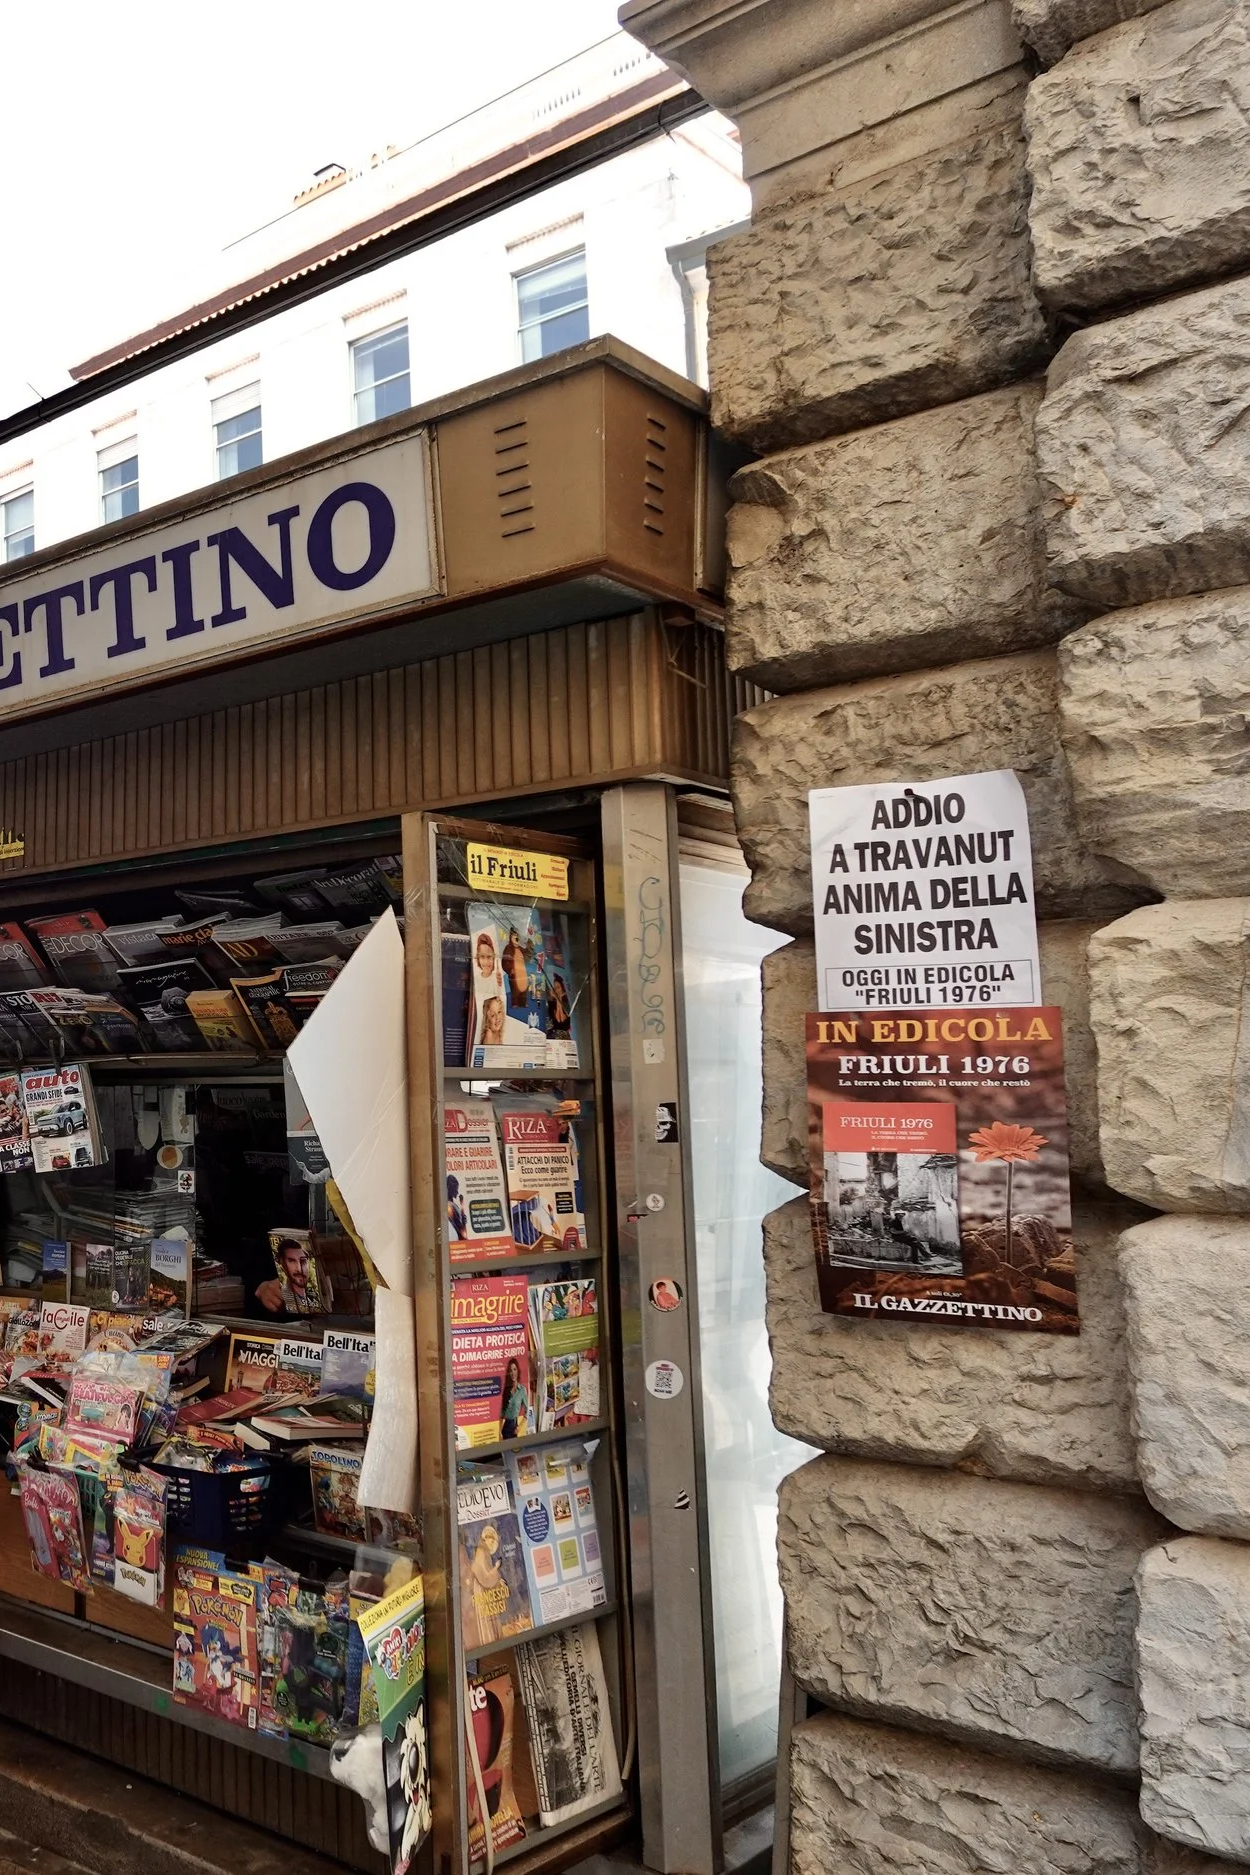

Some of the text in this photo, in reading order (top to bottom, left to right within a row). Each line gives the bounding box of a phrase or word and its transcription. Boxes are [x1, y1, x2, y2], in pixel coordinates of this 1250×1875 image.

[871, 792, 965, 830] ADDIO
[830, 830, 1014, 874] A TRAVANUT
[470, 854, 538, 882] il Friuli
[823, 872, 1028, 915] ANIMA DELLA
[854, 918, 998, 955] SINISTRA
[842, 964, 1015, 987] OGGI IN EDICOLA
[855, 984, 1002, 1005] "FRIULI 1976"
[816, 1017, 1053, 1043] IN EDICOLA
[838, 1055, 1031, 1075] FRIULI 1976
[25, 1070, 80, 1091] auto
[838, 1079, 852, 1087] La
[854, 1079, 881, 1087] terra
[882, 1079, 901, 1087] che
[939, 1079, 947, 1087] il
[949, 1079, 979, 1087] cuore
[981, 1079, 1000, 1087] che
[1002, 1079, 1031, 1087] restò
[507, 1117, 548, 1140] RIZA
[840, 1116, 934, 1129] FRIULI 1976
[5, 1139, 32, 1151] CLASSE
[13, 1147, 31, 1156] NON
[446, 1160, 464, 1172] OLORI
[517, 1156, 543, 1165] ATTACCHI
[550, 1156, 570, 1165] PANICO
[521, 1166, 534, 1175] Ecco
[550, 1165, 568, 1176] guarire
[155, 1254, 182, 1264] BORGHI
[472, 1283, 489, 1291] RIZA
[451, 1289, 525, 1324] imagrire
[853, 1293, 1043, 1322] IL GAZZETTINO
[453, 1332, 526, 1350] DIETA PROTEICA
[459, 1349, 503, 1362] DIMAGRIRE
[504, 1346, 526, 1358] SUBITO
[311, 1451, 360, 1470] TOPOLINO
[457, 1484, 504, 1509] EDIOEVO
[571, 1671, 581, 1715] GEMELLI
[577, 1717, 587, 1757] DIVERSI
